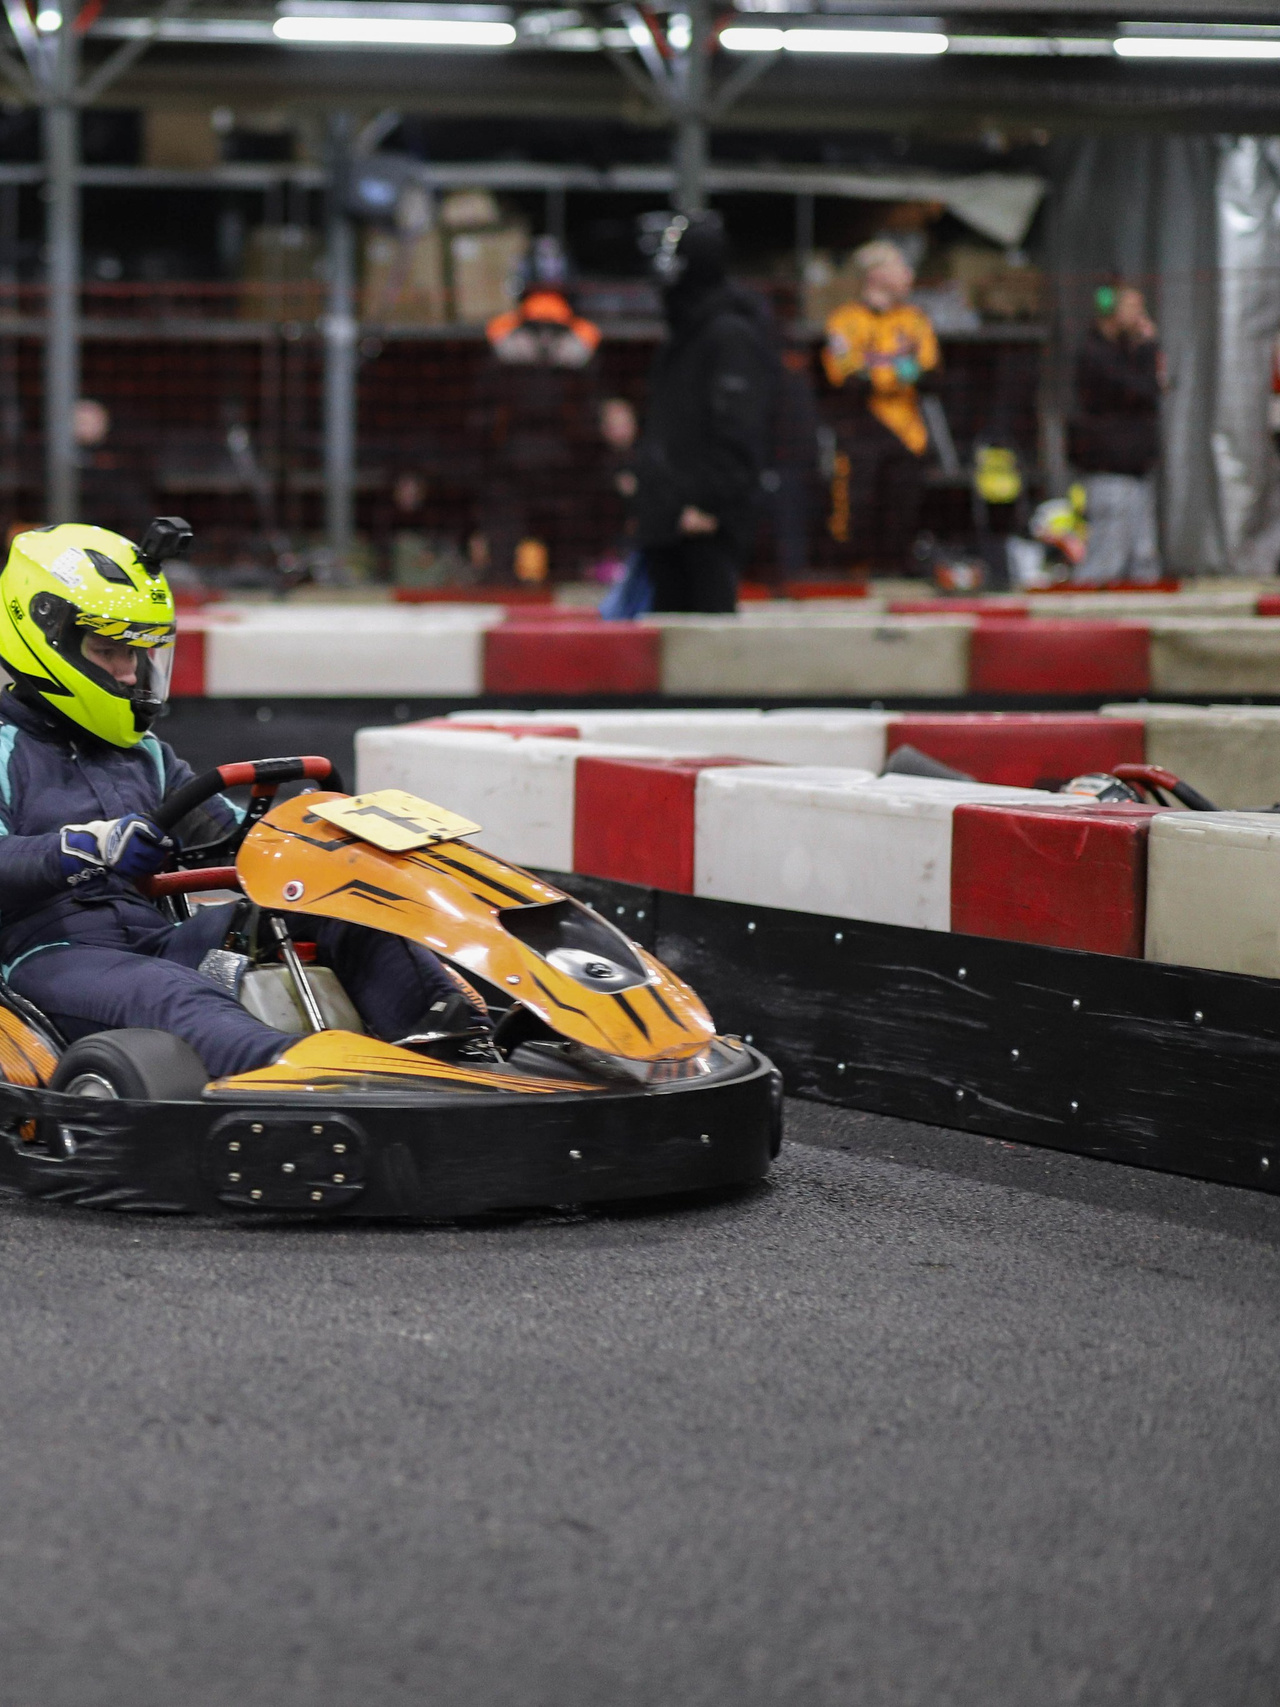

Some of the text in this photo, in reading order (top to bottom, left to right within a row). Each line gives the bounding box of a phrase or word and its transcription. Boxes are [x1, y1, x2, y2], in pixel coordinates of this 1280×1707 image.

[150, 591, 166, 602] OMP
[10, 600, 23, 620] OMP
[122, 630, 141, 640] BE
[141, 633, 160, 643] THE
